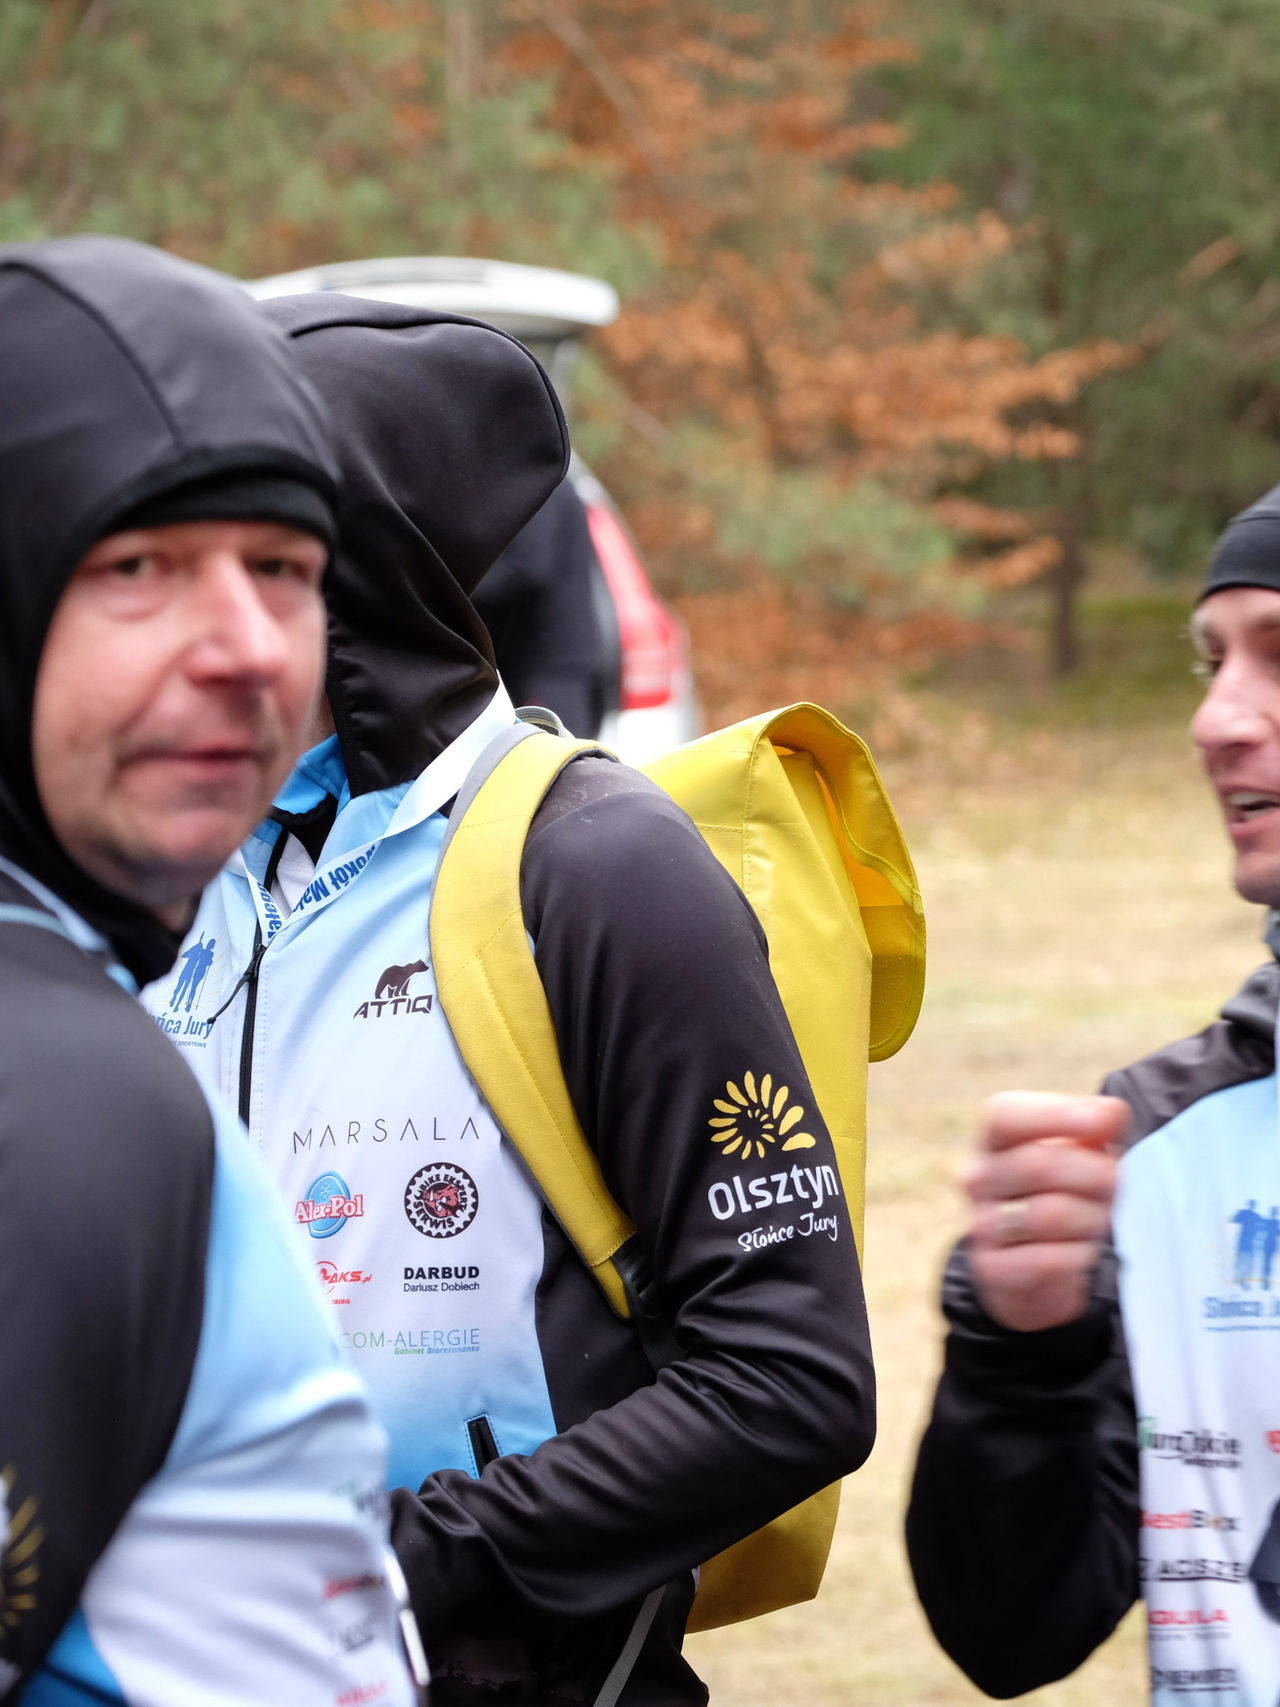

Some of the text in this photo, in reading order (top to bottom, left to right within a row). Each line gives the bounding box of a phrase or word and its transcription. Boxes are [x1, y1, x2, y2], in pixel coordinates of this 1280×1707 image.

[352, 994, 434, 1020] ATTIQ
[292, 1116, 480, 1154] MARSALA
[418, 1173, 442, 1191] BIKE
[707, 1164, 840, 1221] Olsztyn
[293, 1194, 364, 1224] Alex-Pol
[412, 1200, 455, 1230] SERWIS
[737, 1212, 839, 1252] Słońce Jury
[403, 1266, 480, 1280] DARBUD
[403, 1282, 480, 1292] Dariusz Dobiech
